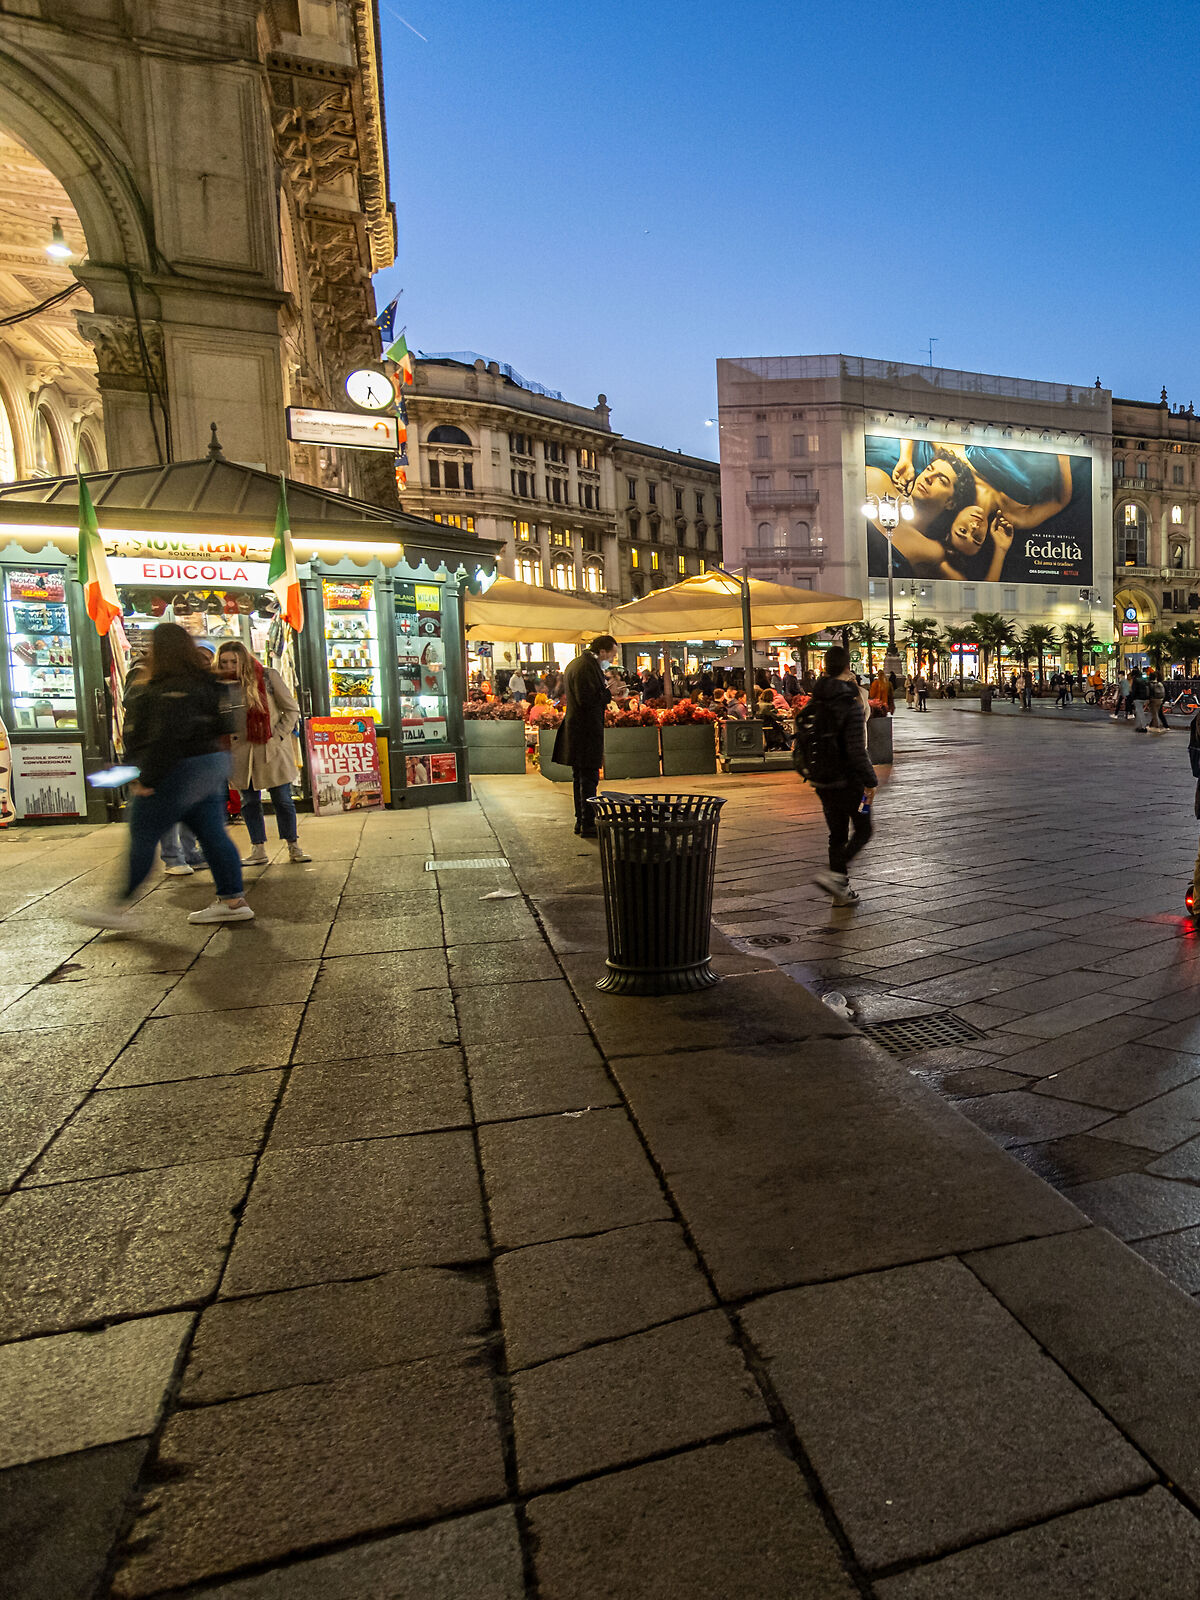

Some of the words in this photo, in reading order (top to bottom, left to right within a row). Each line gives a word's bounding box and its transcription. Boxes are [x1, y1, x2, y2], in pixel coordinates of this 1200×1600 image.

[1024, 539, 1083, 560] fedeltà
[143, 563, 249, 581] EDICOLA
[313, 743, 375, 759] TICKETS
[319, 757, 374, 774] HERE
